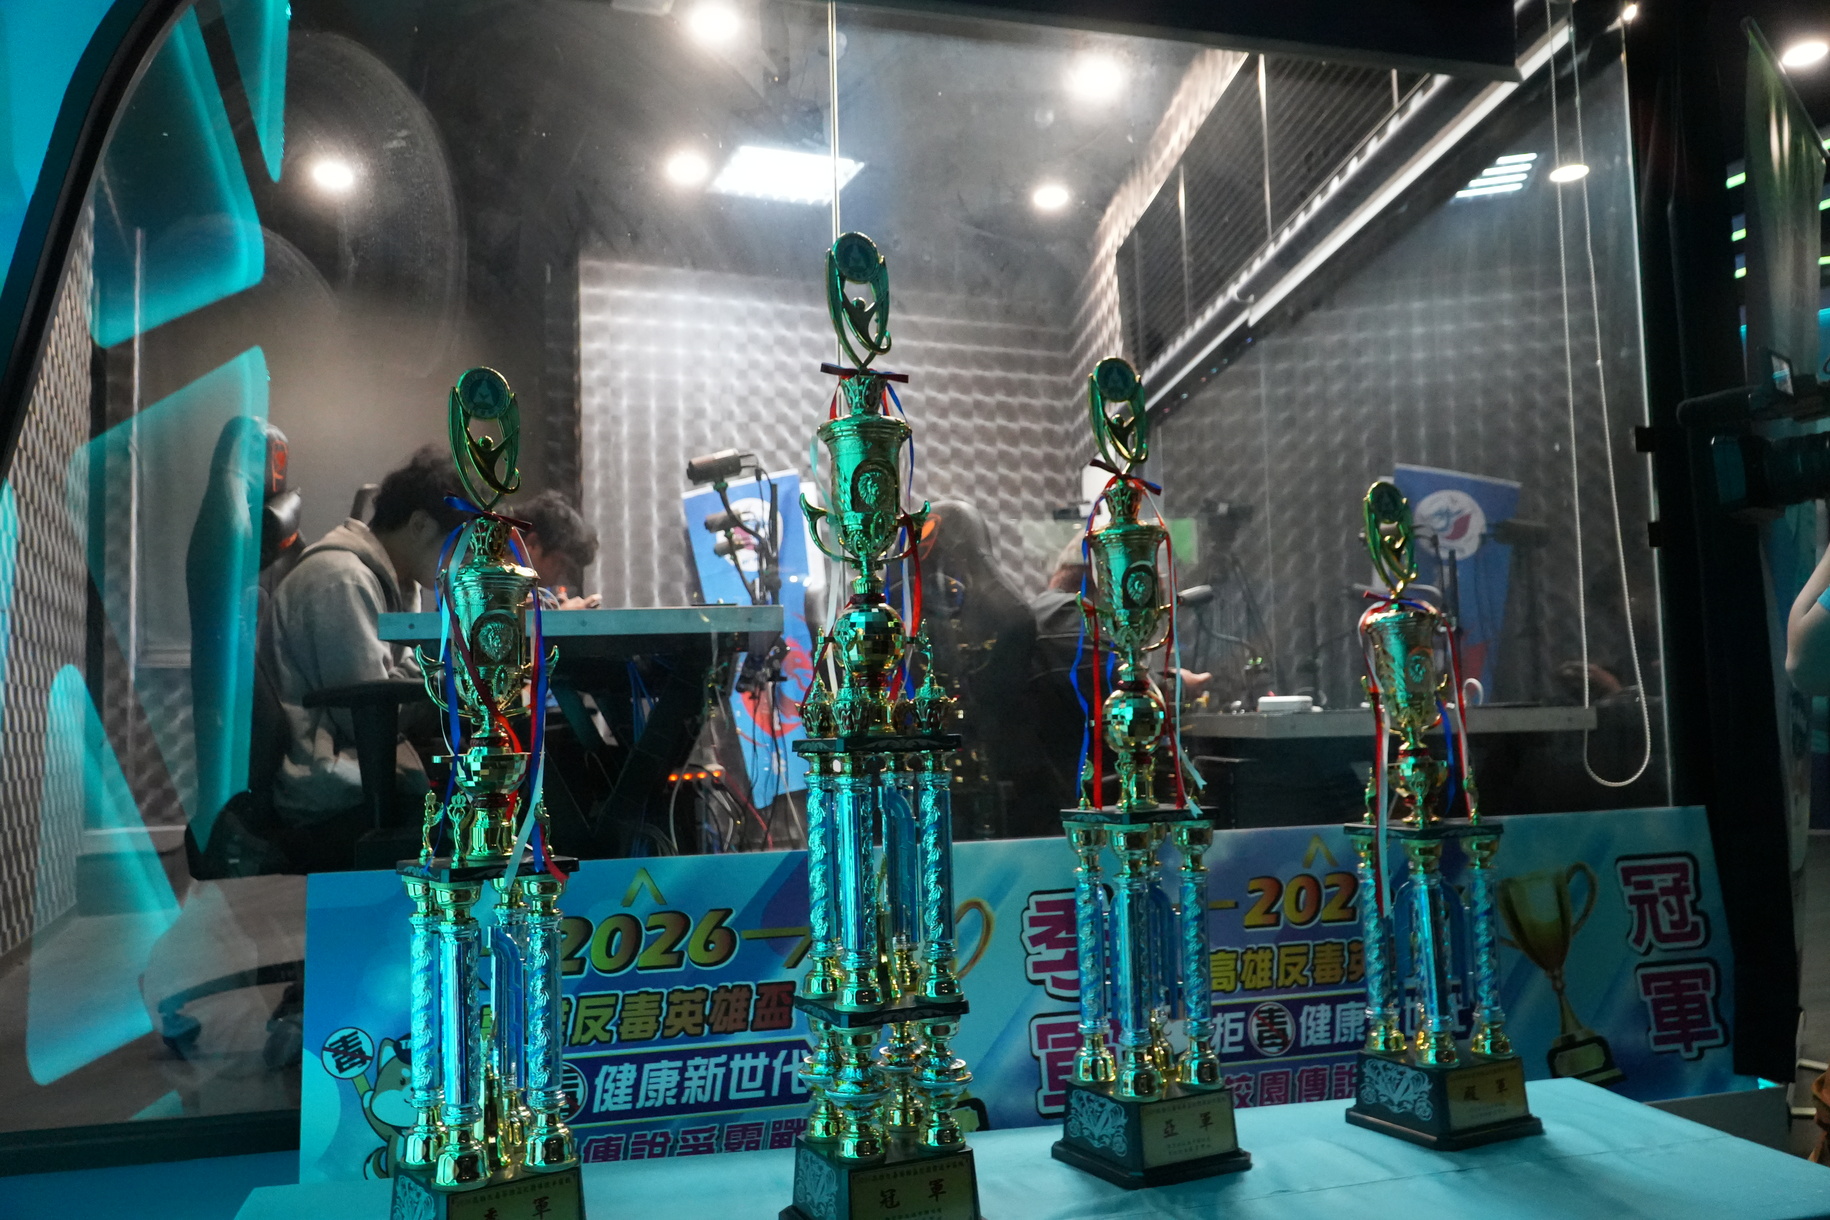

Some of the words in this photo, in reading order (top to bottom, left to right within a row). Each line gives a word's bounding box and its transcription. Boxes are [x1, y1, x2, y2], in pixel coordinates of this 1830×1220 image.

[1244, 872, 1360, 930] 202
[562, 908, 737, 975] 2026
[1616, 856, 1725, 1058] 冠軍
[562, 981, 797, 1046] 反毒英雄盃
